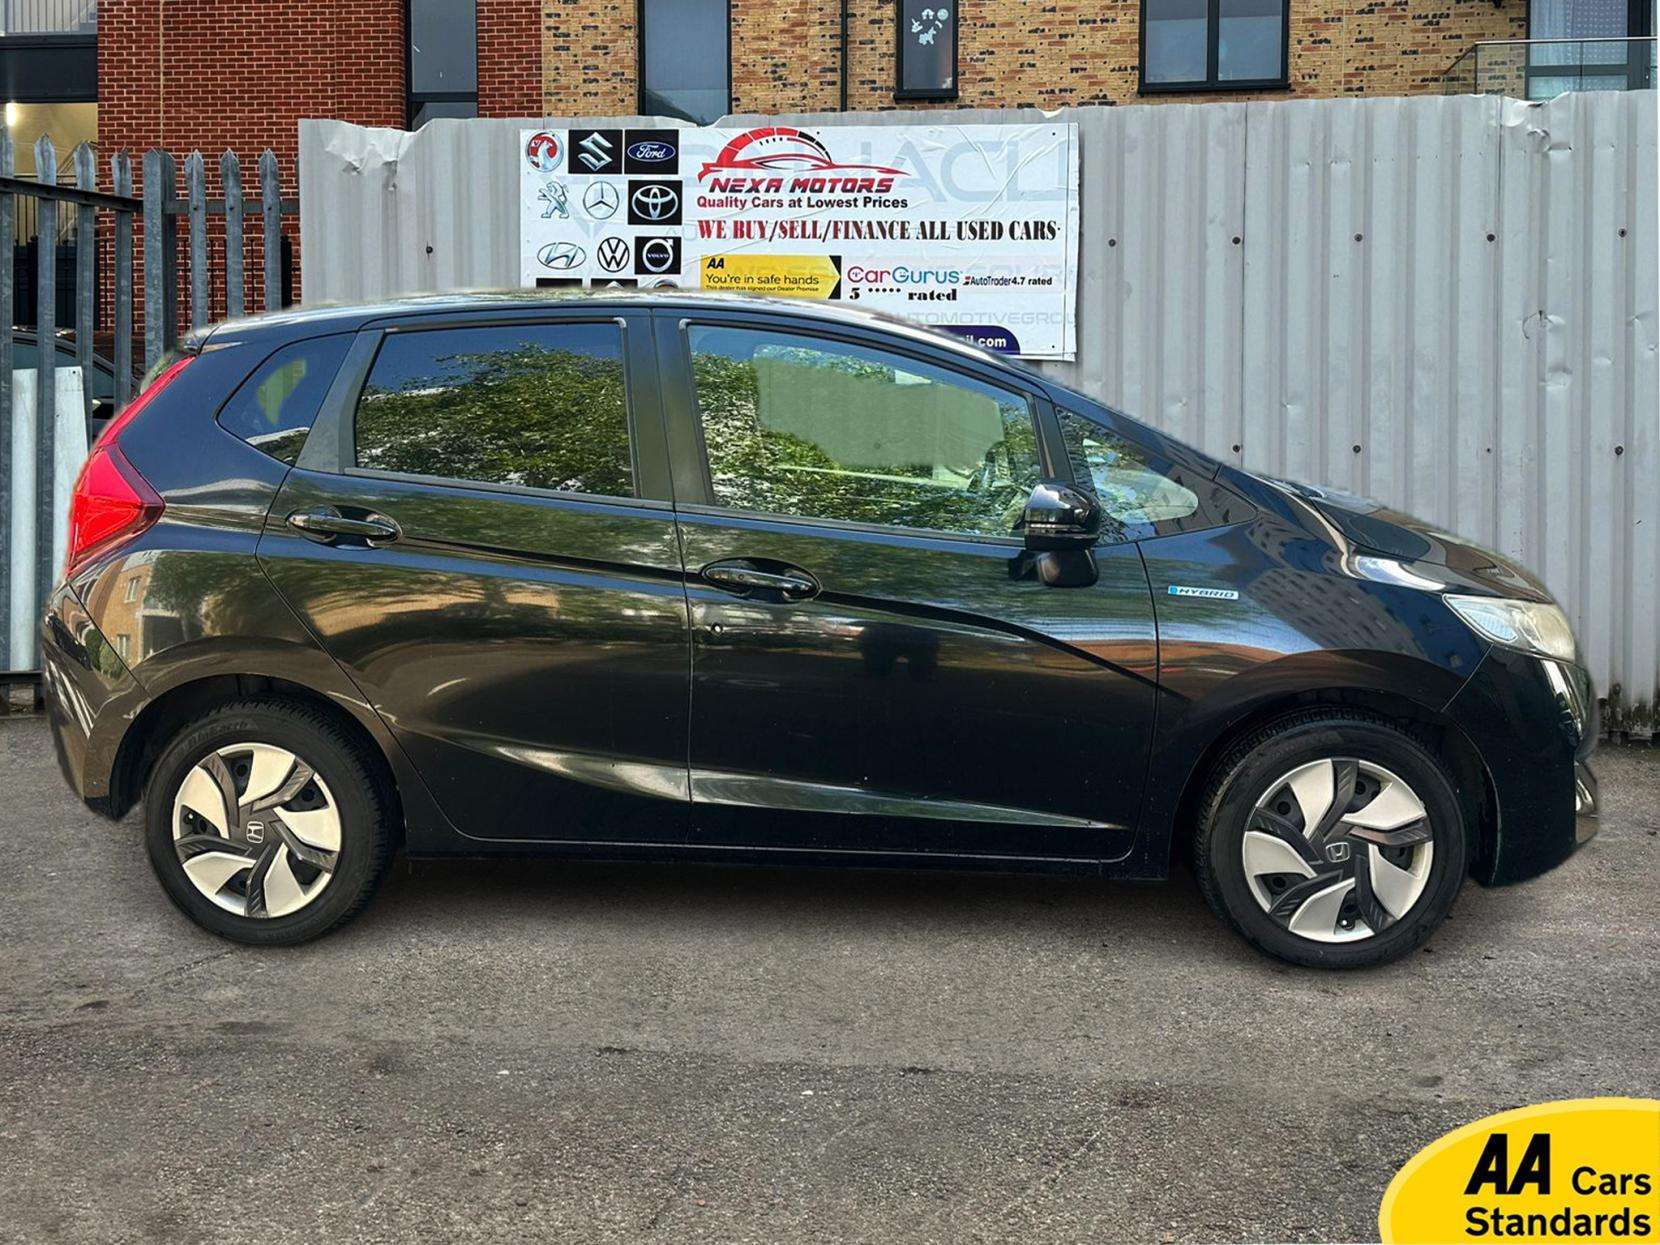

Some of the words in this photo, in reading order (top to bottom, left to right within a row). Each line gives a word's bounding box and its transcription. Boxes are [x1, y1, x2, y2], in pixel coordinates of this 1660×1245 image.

[636, 144, 666, 158] Ford
[709, 178, 784, 193] NEXA
[789, 178, 894, 193] MOTORS
[697, 196, 747, 210] Quality
[751, 196, 784, 208] Cars
[789, 197, 803, 208] at
[807, 196, 858, 208] Lowest
[863, 196, 908, 208] Prices
[697, 219, 726, 240] WE
[916, 220, 951, 240] ALL
[957, 220, 1003, 241] USED
[1009, 220, 1057, 241] CARS
[707, 258, 725, 269] AA
[705, 273, 741, 284] You're
[744, 274, 754, 284] in
[757, 274, 781, 285] safe
[784, 274, 820, 285] hands
[847, 266, 960, 284] CarGurus
[1028, 276, 1053, 286] rated
[849, 287, 861, 300] 5
[908, 288, 957, 301] rated
[1179, 587, 1235, 599] HYBRID
